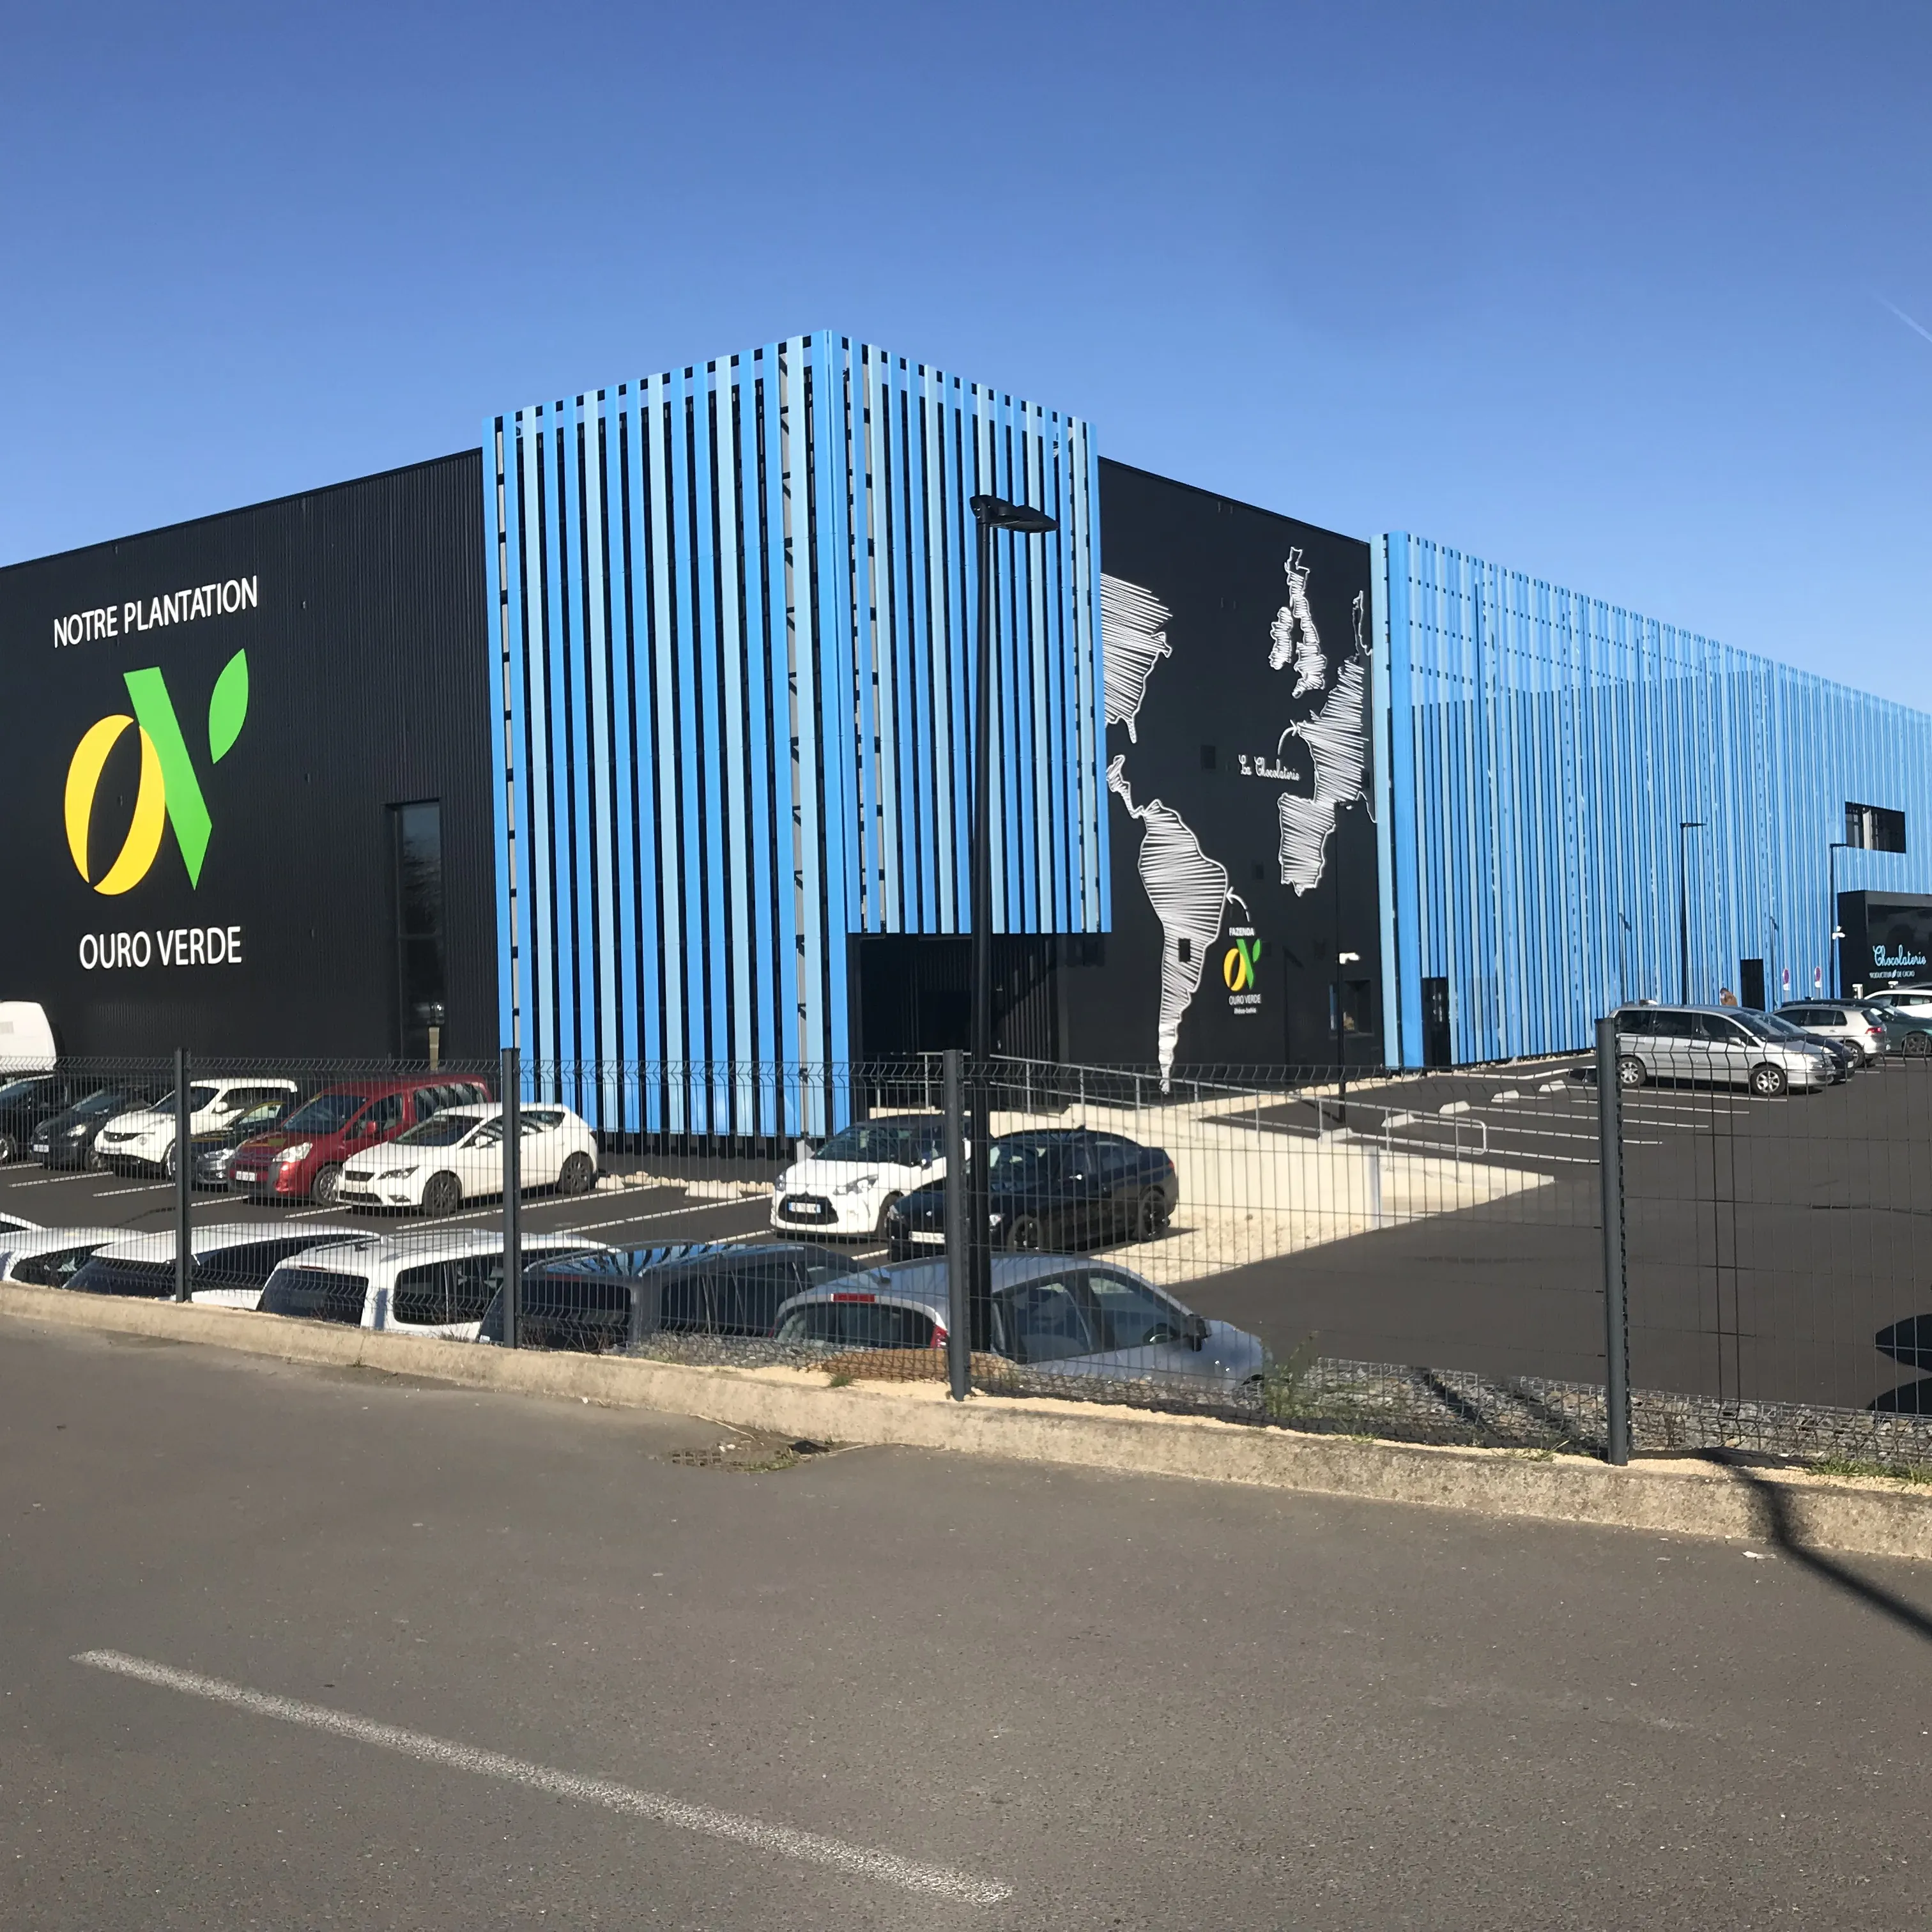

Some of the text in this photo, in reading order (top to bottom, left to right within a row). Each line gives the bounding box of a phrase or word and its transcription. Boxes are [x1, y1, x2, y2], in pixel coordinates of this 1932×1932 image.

[54, 576, 257, 648] NOTRE PLANTATION
[1254, 756, 1300, 781] Chocolaterie
[1229, 927, 1255, 936] FAZENDA
[79, 926, 242, 970] OURO VERDE
[1873, 944, 1926, 966] Chocolaterie
[1229, 995, 1244, 1005] OURO
